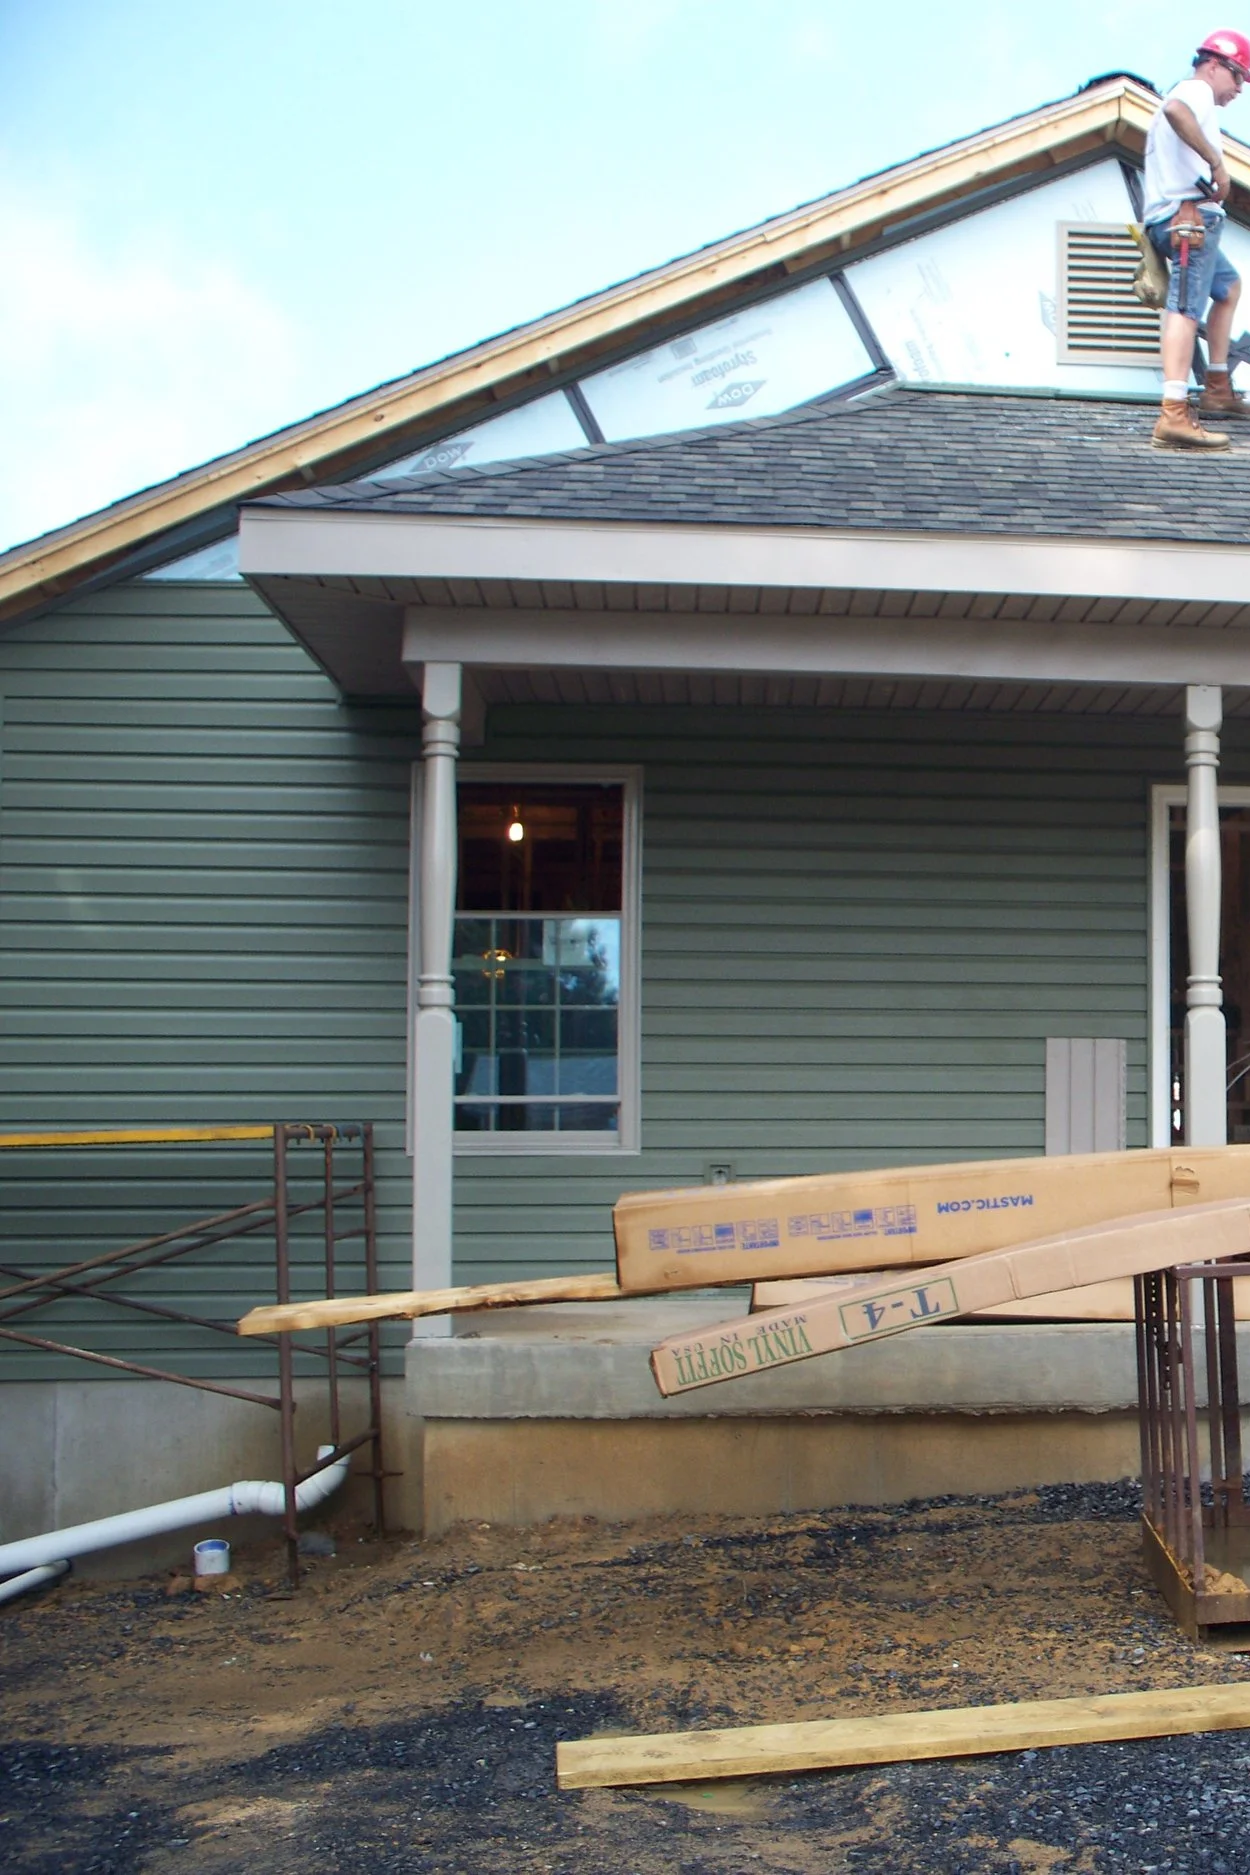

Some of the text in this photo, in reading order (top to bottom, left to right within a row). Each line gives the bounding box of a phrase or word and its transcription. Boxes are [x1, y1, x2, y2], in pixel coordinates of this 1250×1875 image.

[691, 348, 757, 389] Styrofoam
[714, 383, 755, 406] DOW
[424, 446, 463, 468] DOW
[937, 1194, 1034, 1215] MASTIC.COM
[863, 1287, 940, 1331] T-4
[670, 1314, 807, 1357] MADE IN USA
[675, 1326, 813, 1386] VINYL SOFFIT
